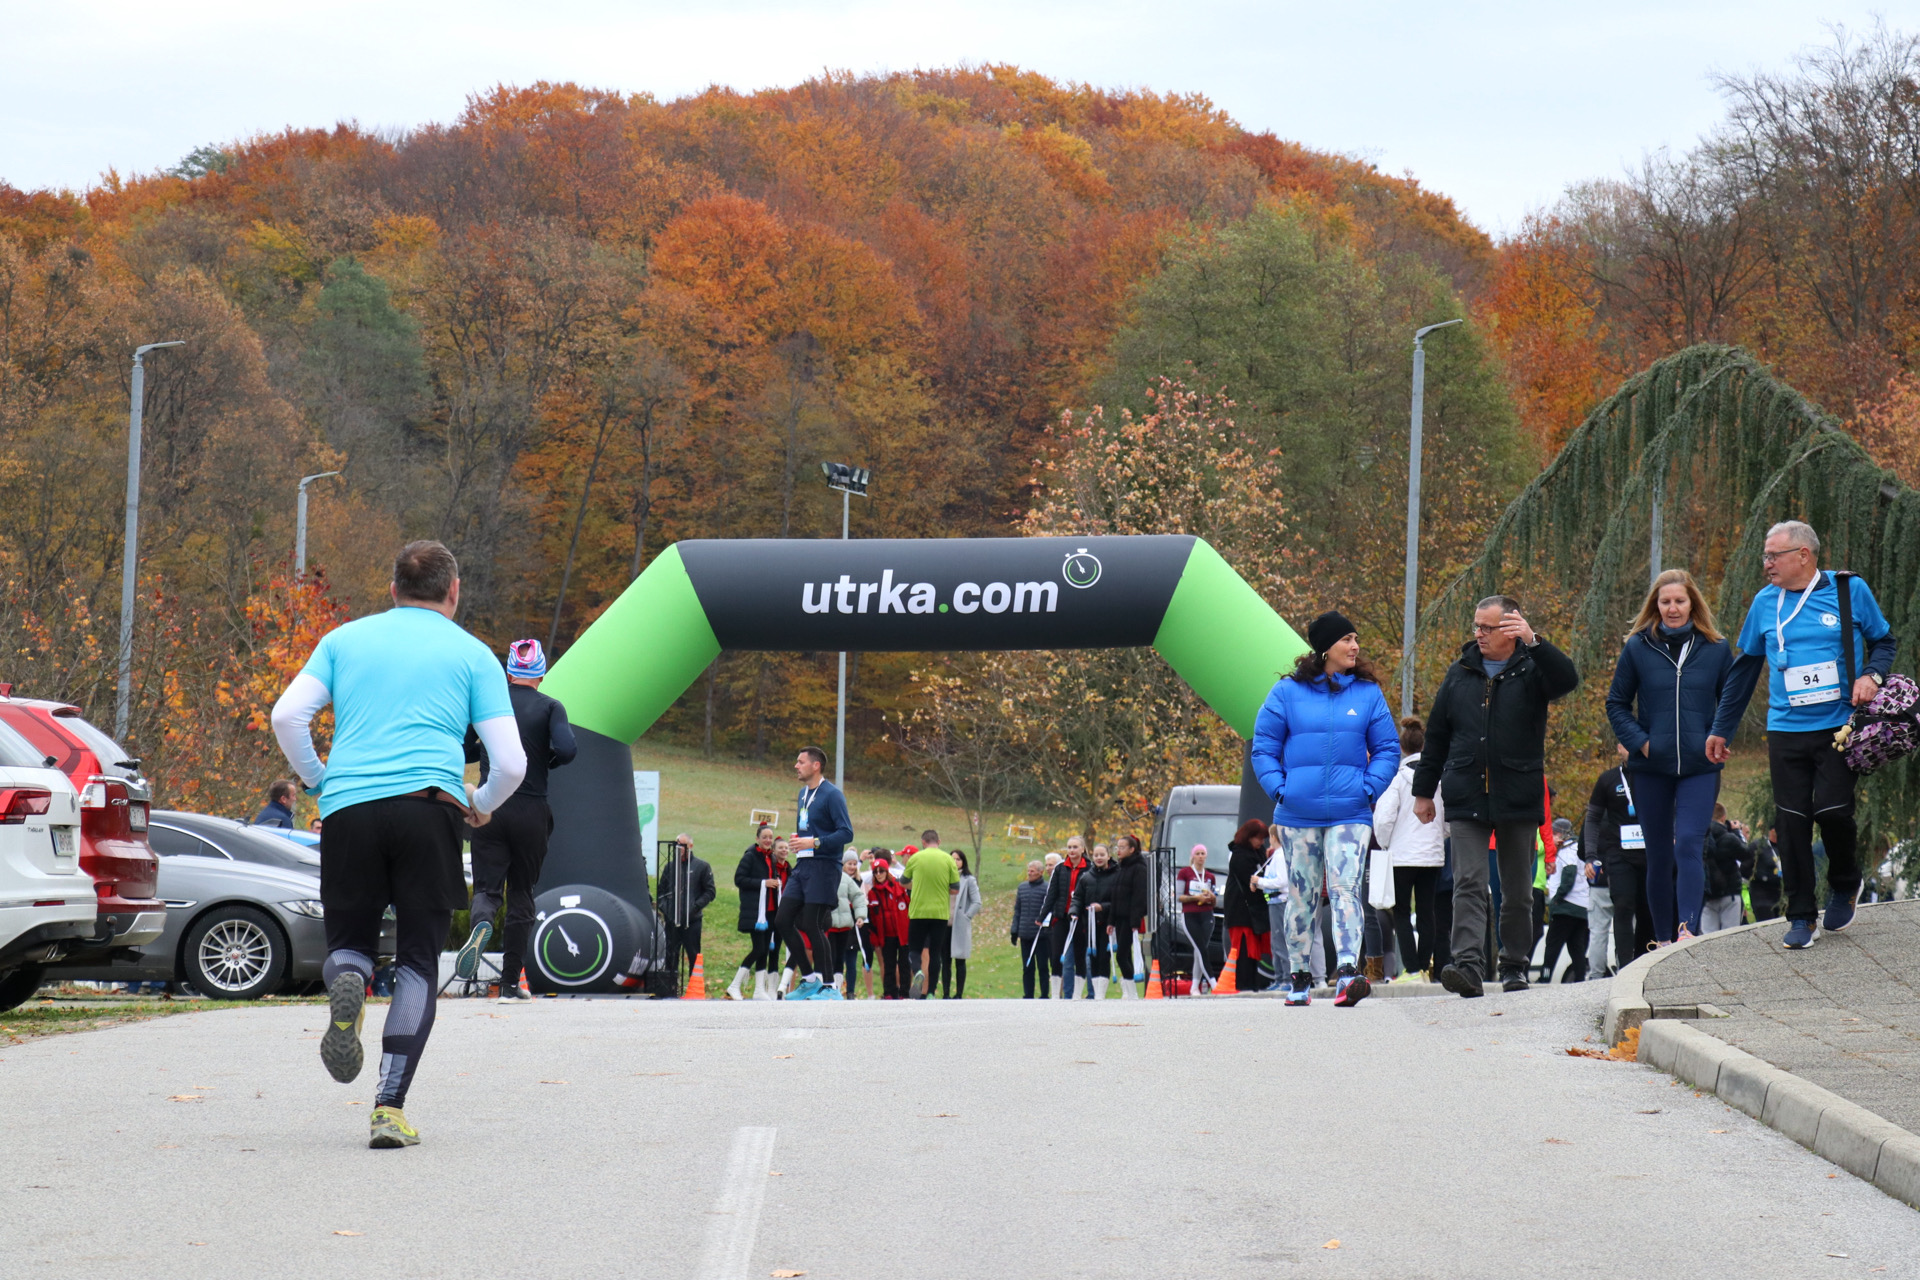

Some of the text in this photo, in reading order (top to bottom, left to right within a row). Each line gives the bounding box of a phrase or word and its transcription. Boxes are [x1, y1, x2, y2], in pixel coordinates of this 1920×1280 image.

[801, 568, 1059, 614] utrka.com
[1803, 673, 1820, 686] 94
[758, 814, 771, 823] 175
